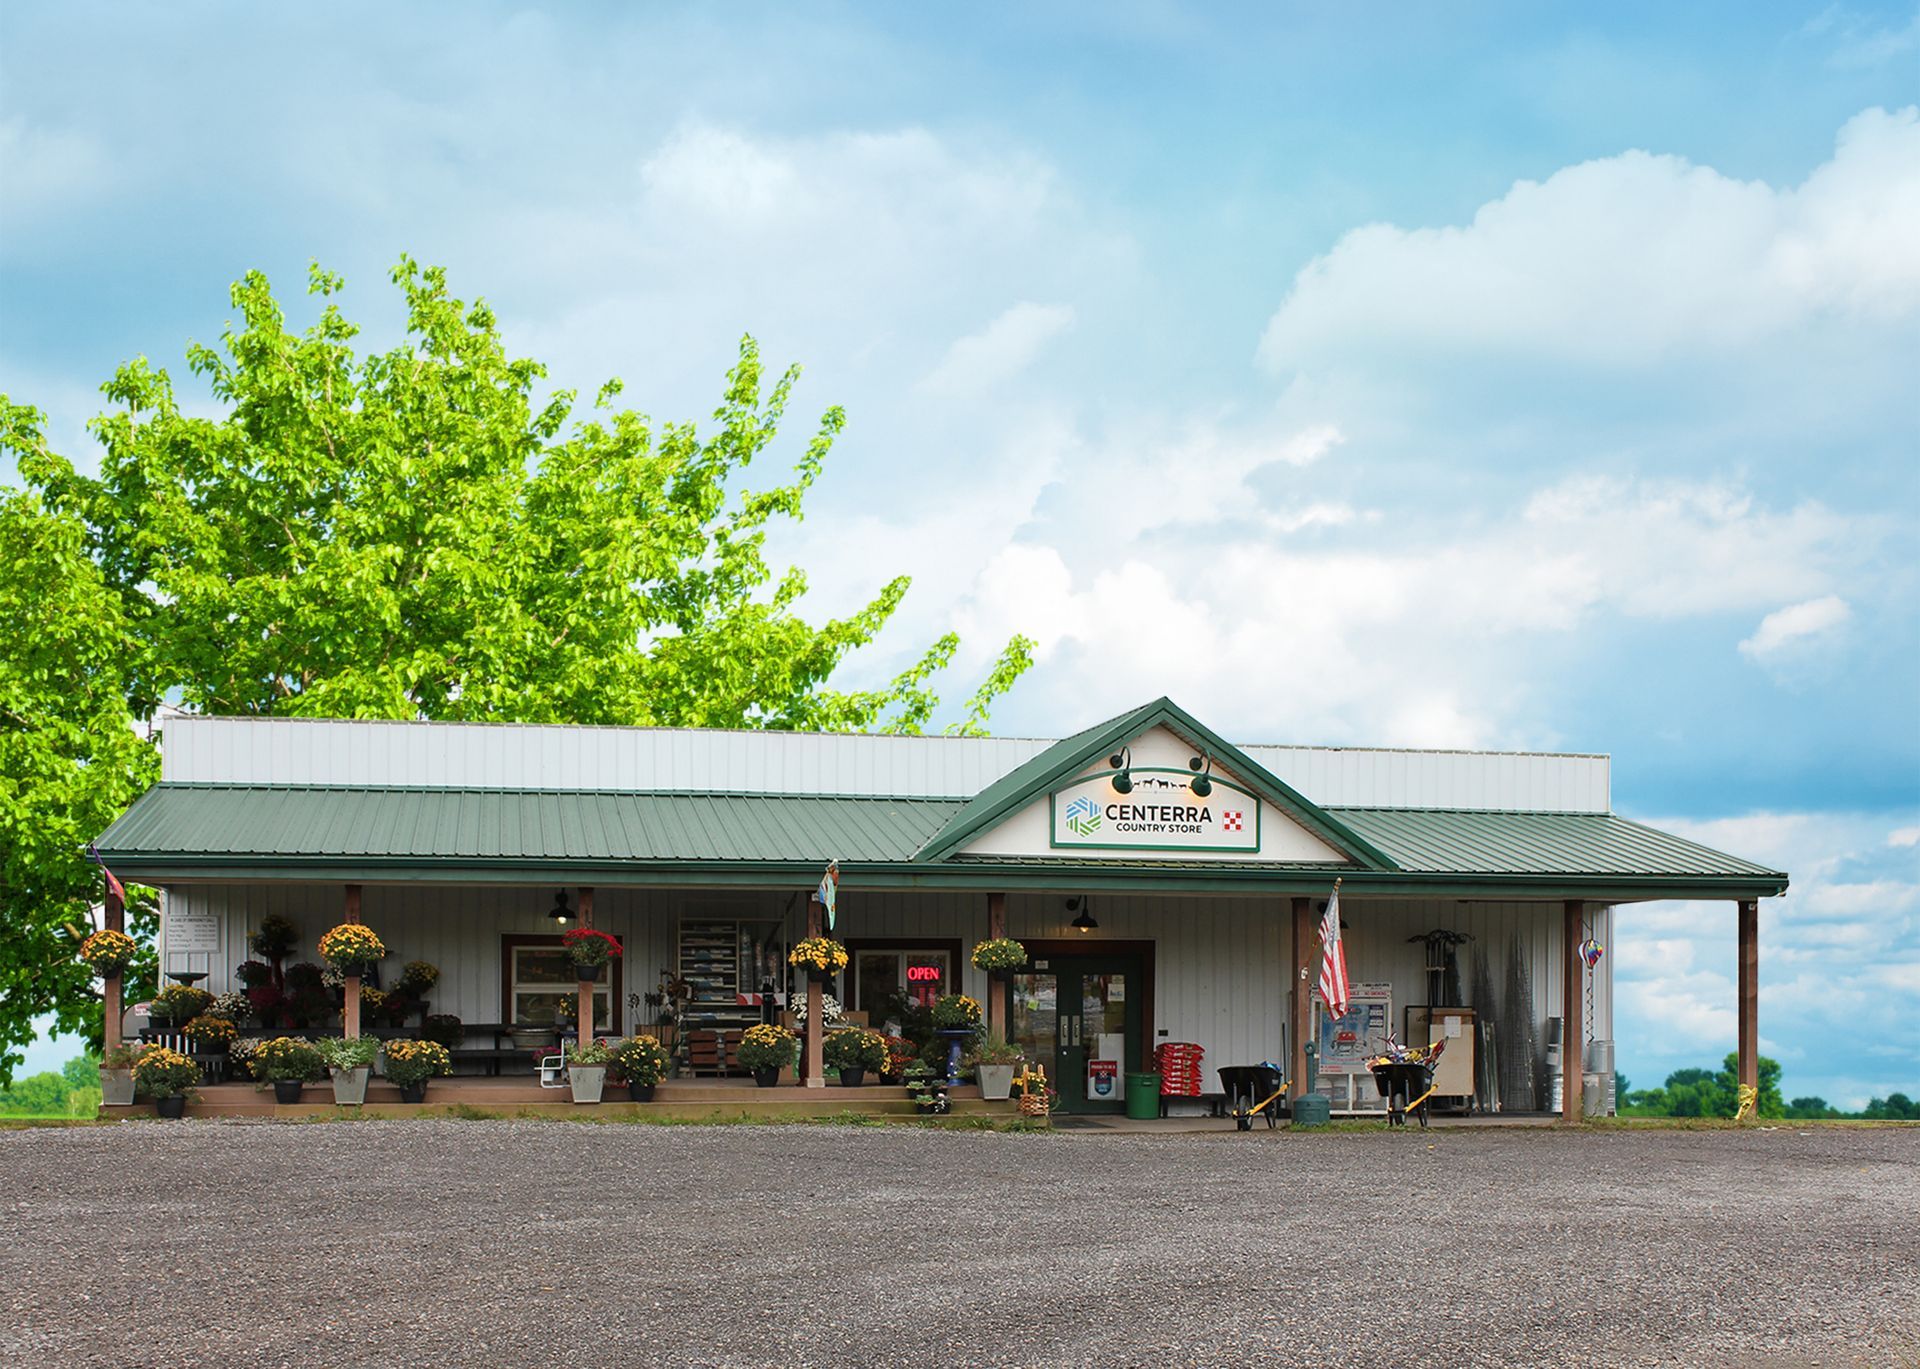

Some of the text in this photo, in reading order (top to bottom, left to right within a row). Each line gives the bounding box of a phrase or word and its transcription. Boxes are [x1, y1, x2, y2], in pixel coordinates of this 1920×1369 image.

[1105, 804, 1213, 823] CENTERRA
[1116, 823, 1202, 833] COUNTRY STORE
[908, 967, 939, 980] OPEN
